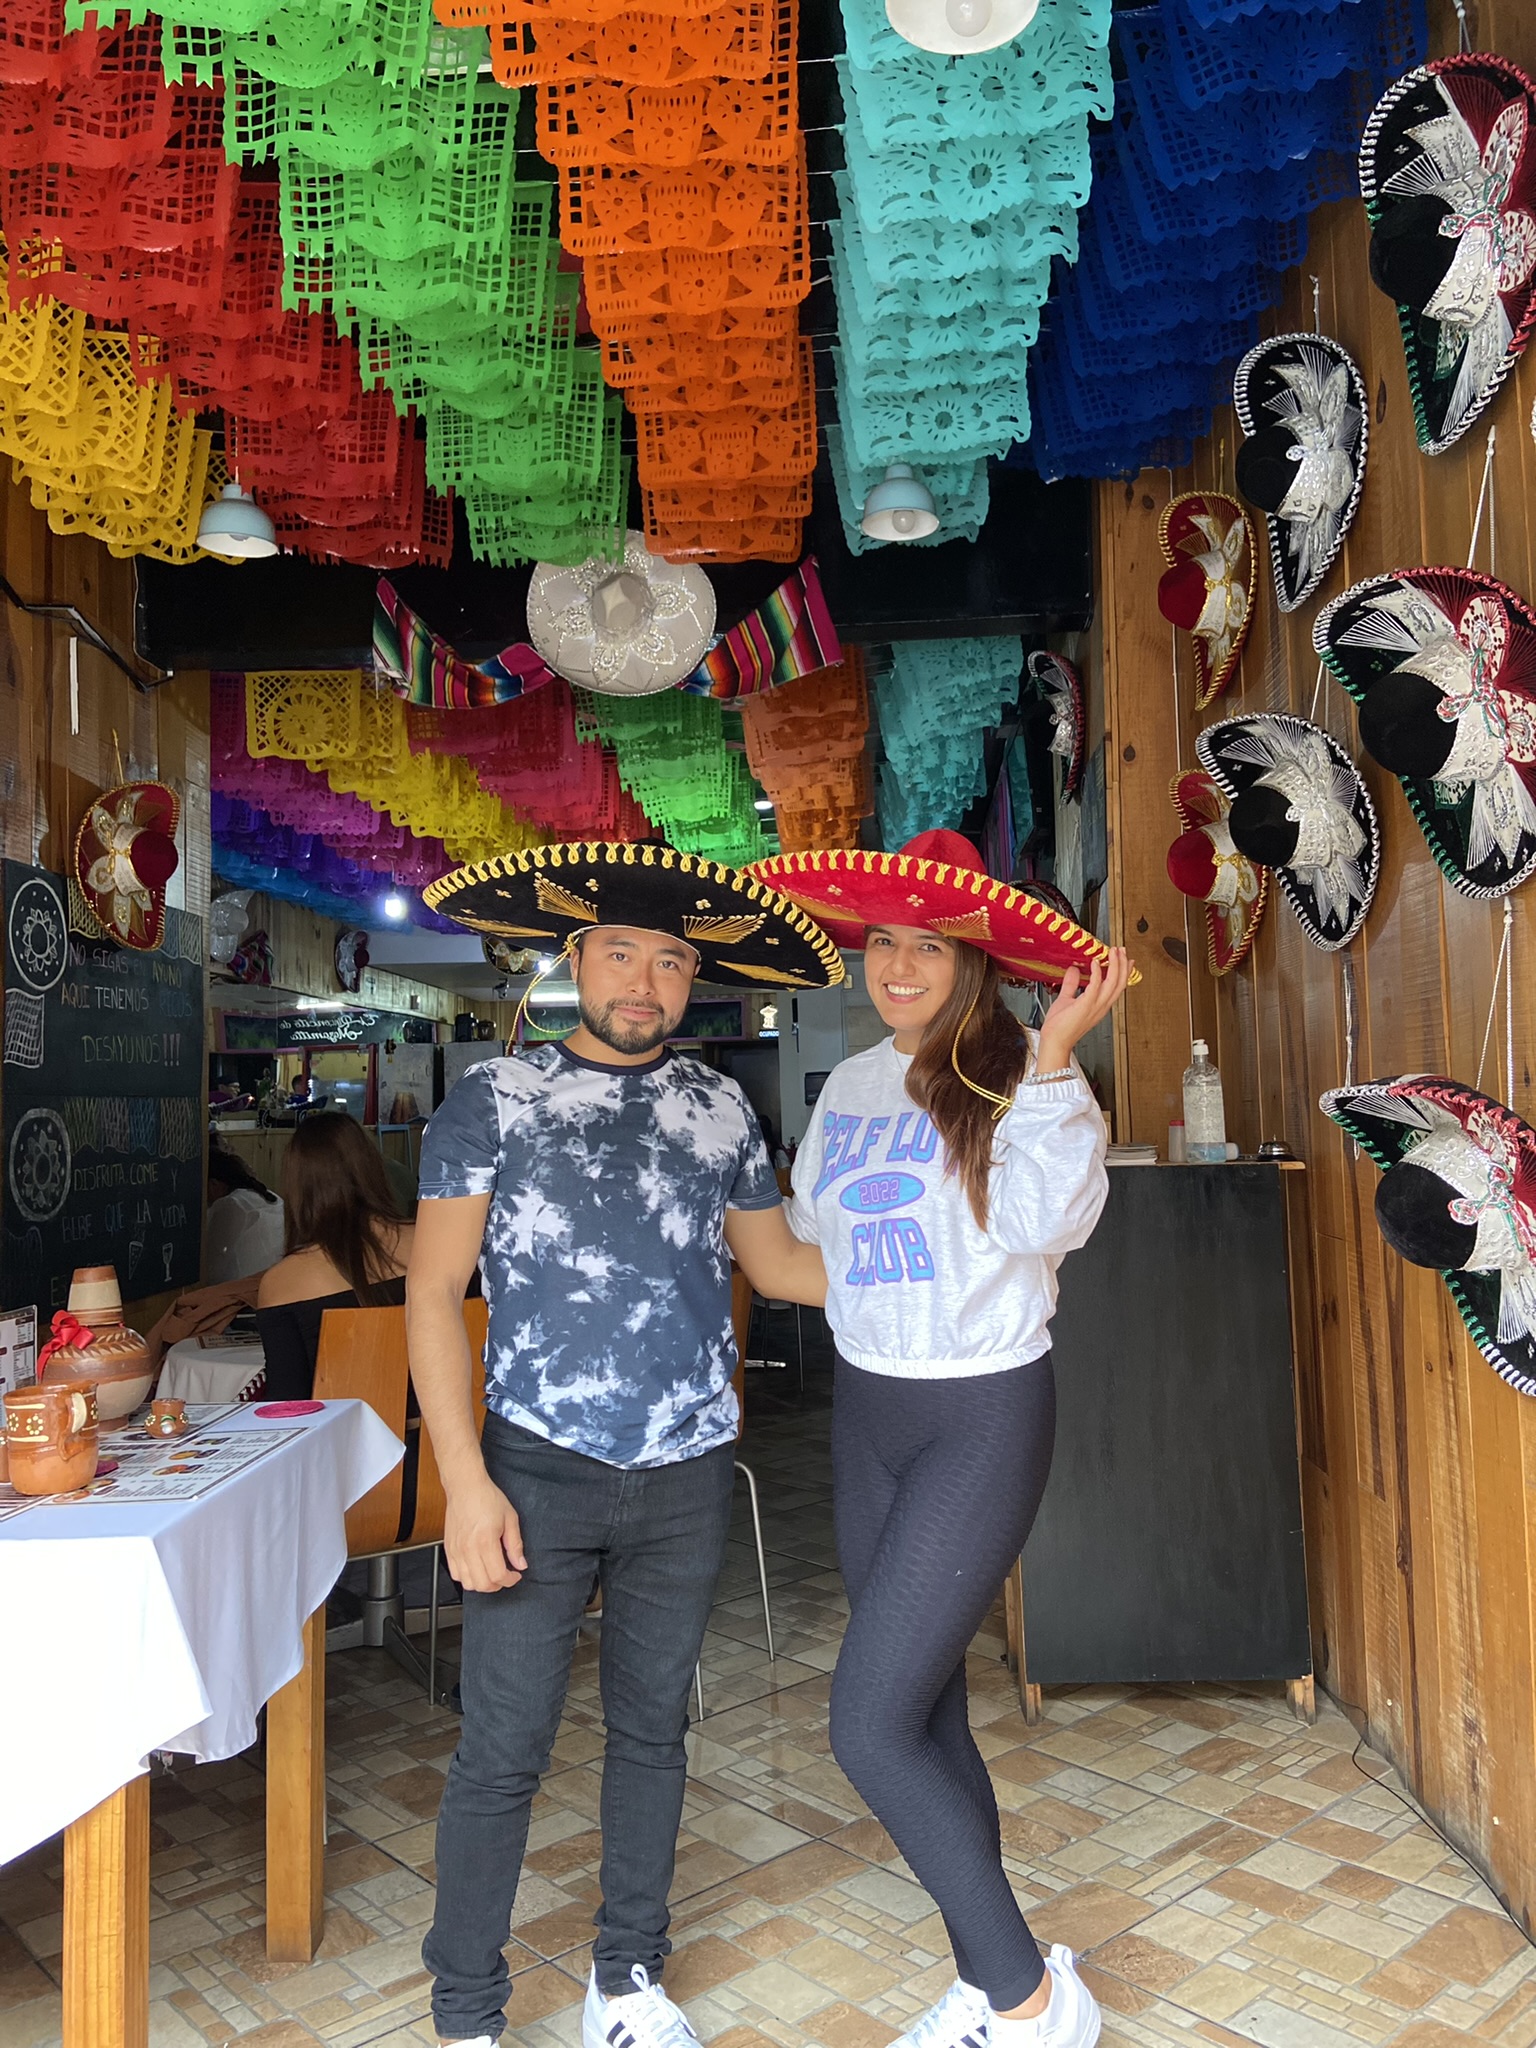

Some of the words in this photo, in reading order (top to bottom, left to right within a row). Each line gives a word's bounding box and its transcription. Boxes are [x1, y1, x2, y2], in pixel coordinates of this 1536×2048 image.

[69, 942, 87, 967] NO
[92, 948, 129, 974] SIGAS
[152, 960, 182, 989] AYUNO
[62, 982, 90, 1008] AQUI
[95, 986, 149, 1012] TENEMOS
[159, 990, 193, 1018] RICOS
[129, 1162, 159, 1186] COME
[170, 1168, 178, 1193] Y
[860, 1179, 899, 1206] 2022
[105, 1201, 125, 1237] QUE
[137, 1199, 152, 1224] LA
[160, 1203, 188, 1229] VIDA
[846, 1217, 935, 1286] CLUB
